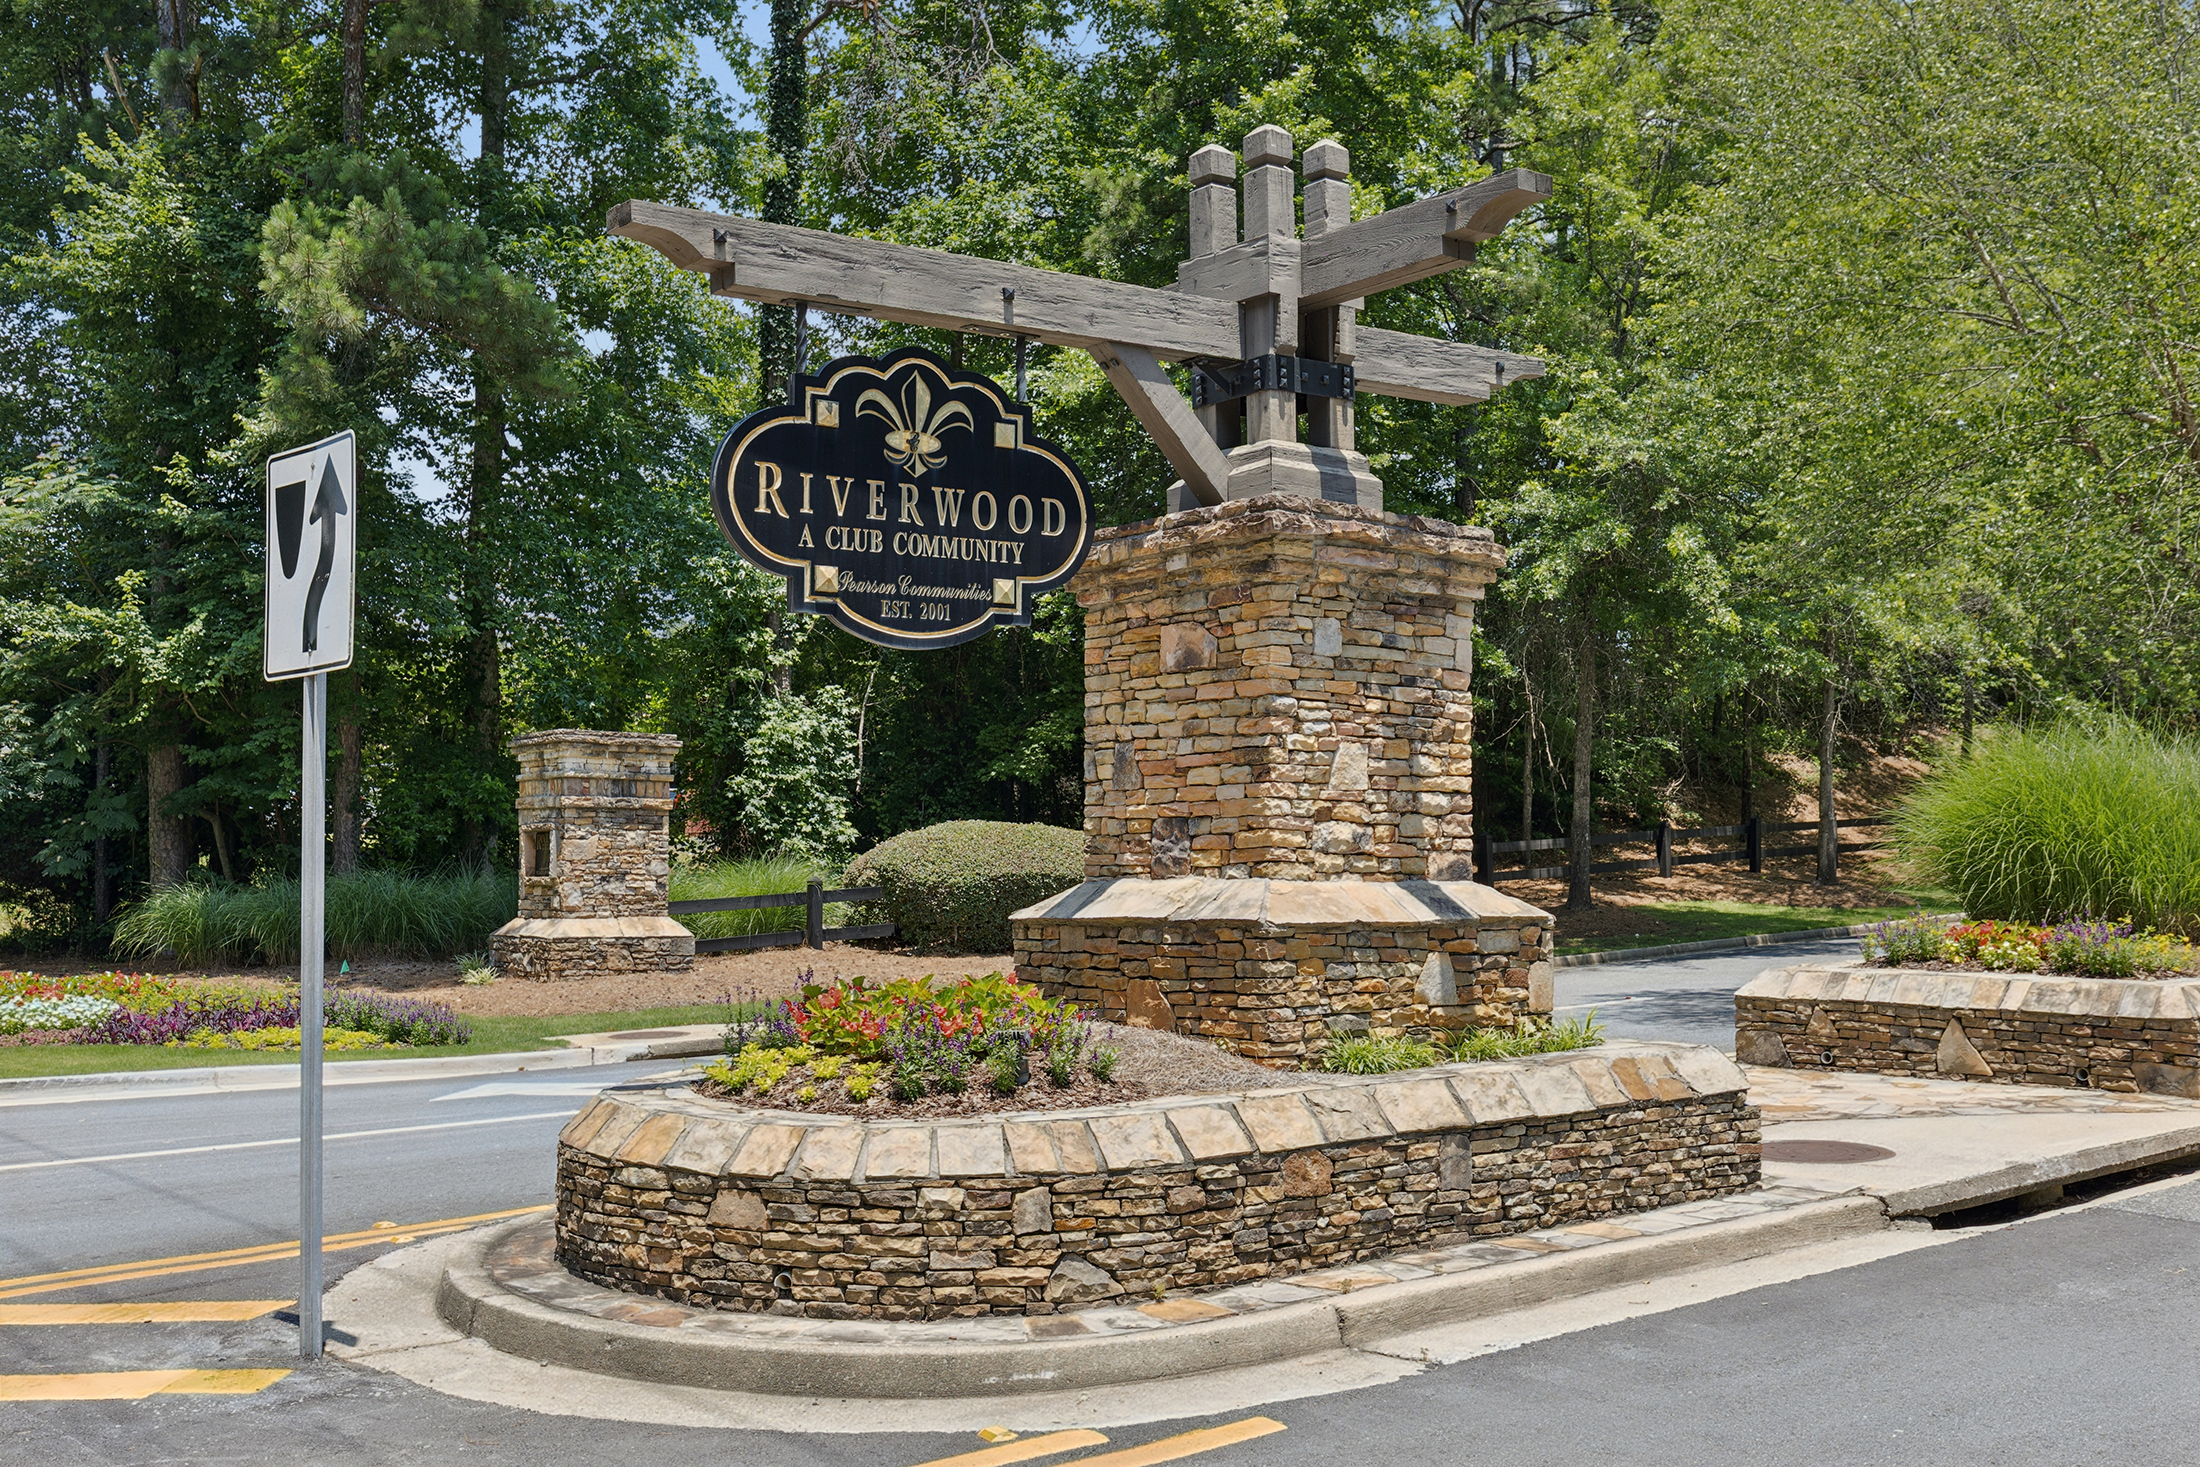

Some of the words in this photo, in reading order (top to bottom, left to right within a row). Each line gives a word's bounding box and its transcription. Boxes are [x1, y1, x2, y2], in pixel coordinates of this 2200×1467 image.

[754, 461, 1066, 537] RIVERWOOD
[798, 523, 814, 548] A
[825, 526, 883, 553] CLUB
[893, 532, 1025, 564] COMMUNITY
[838, 570, 897, 594] Pearson
[898, 575, 992, 601] Communities
[881, 600, 912, 619] EST.
[920, 603, 951, 622] 2001
